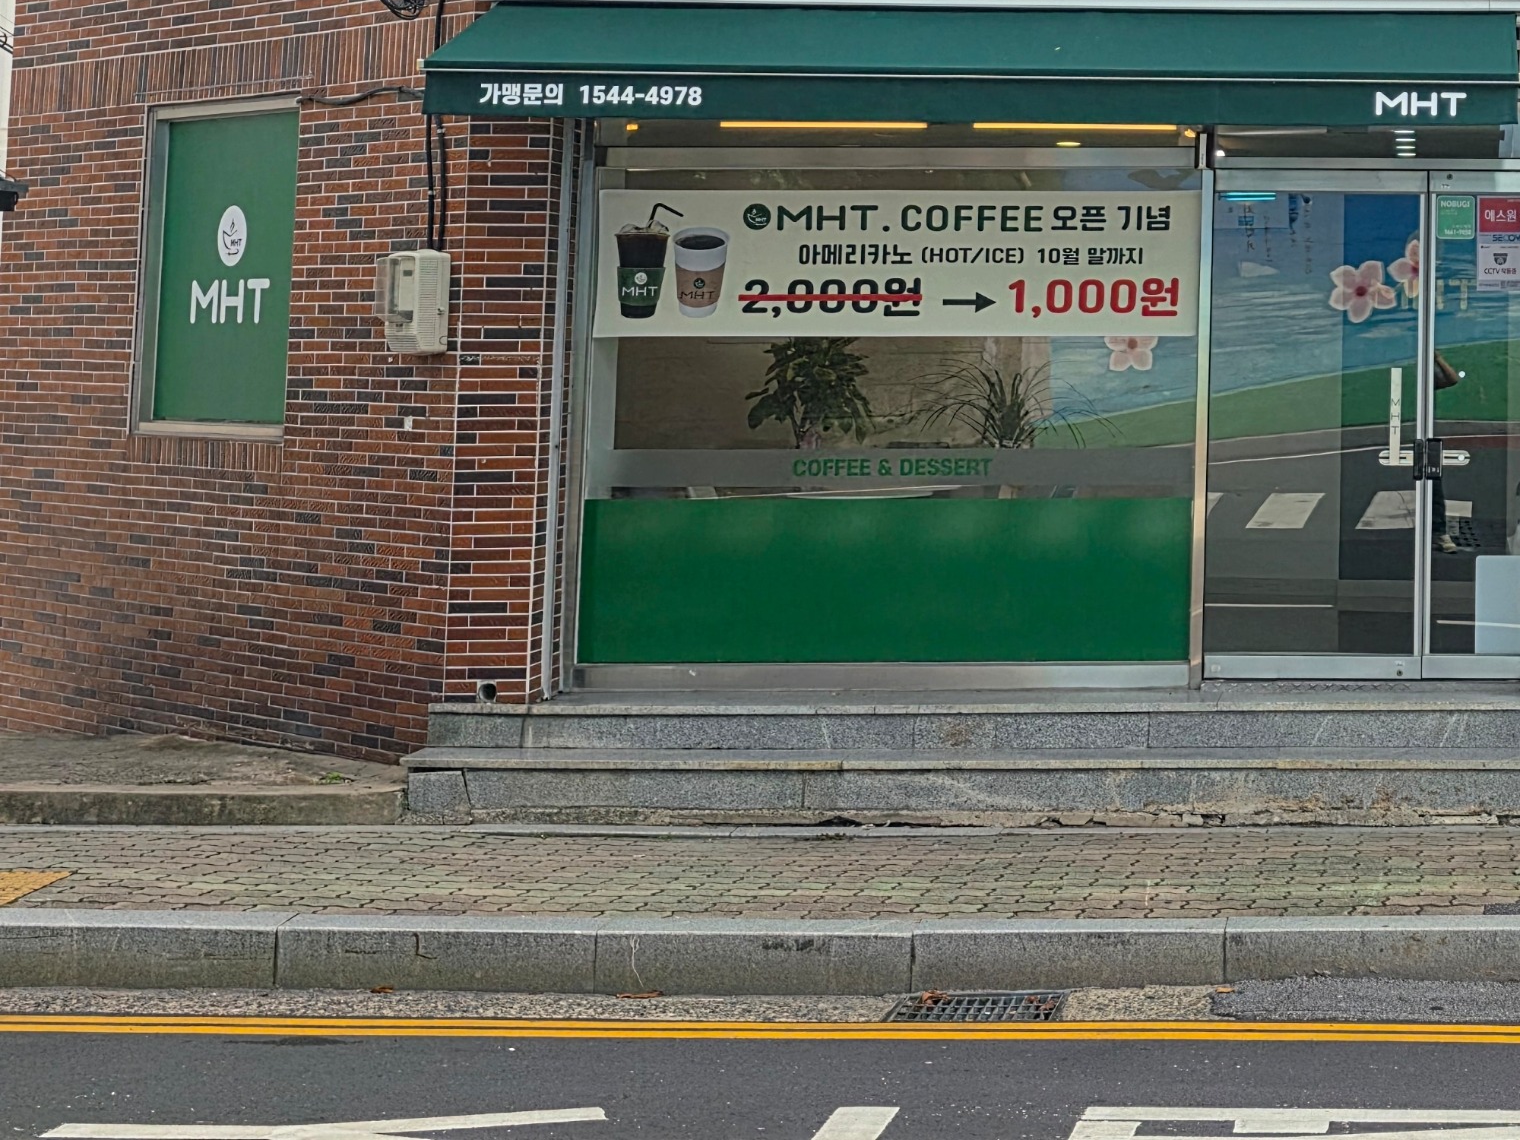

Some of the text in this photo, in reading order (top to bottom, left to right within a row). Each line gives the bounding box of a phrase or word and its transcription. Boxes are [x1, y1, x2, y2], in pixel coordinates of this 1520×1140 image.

[479, 83, 703, 106] 가맹문의 1544-4978
[1375, 91, 1468, 117] MHT
[901, 204, 1044, 232] COFFEE
[1051, 205, 1107, 232] 오픈
[1117, 205, 1172, 232] 기념
[1484, 209, 1517, 222] 에스원
[798, 244, 1144, 266] 아메리카노 (HOT/ICE) 10월 말까지
[190, 278, 271, 324] MHT
[621, 286, 659, 297] MHT
[679, 290, 716, 300] MHT
[741, 277, 1180, 319] 2,000원 1,000원
[792, 458, 993, 477] COFFEE & DESSERT
